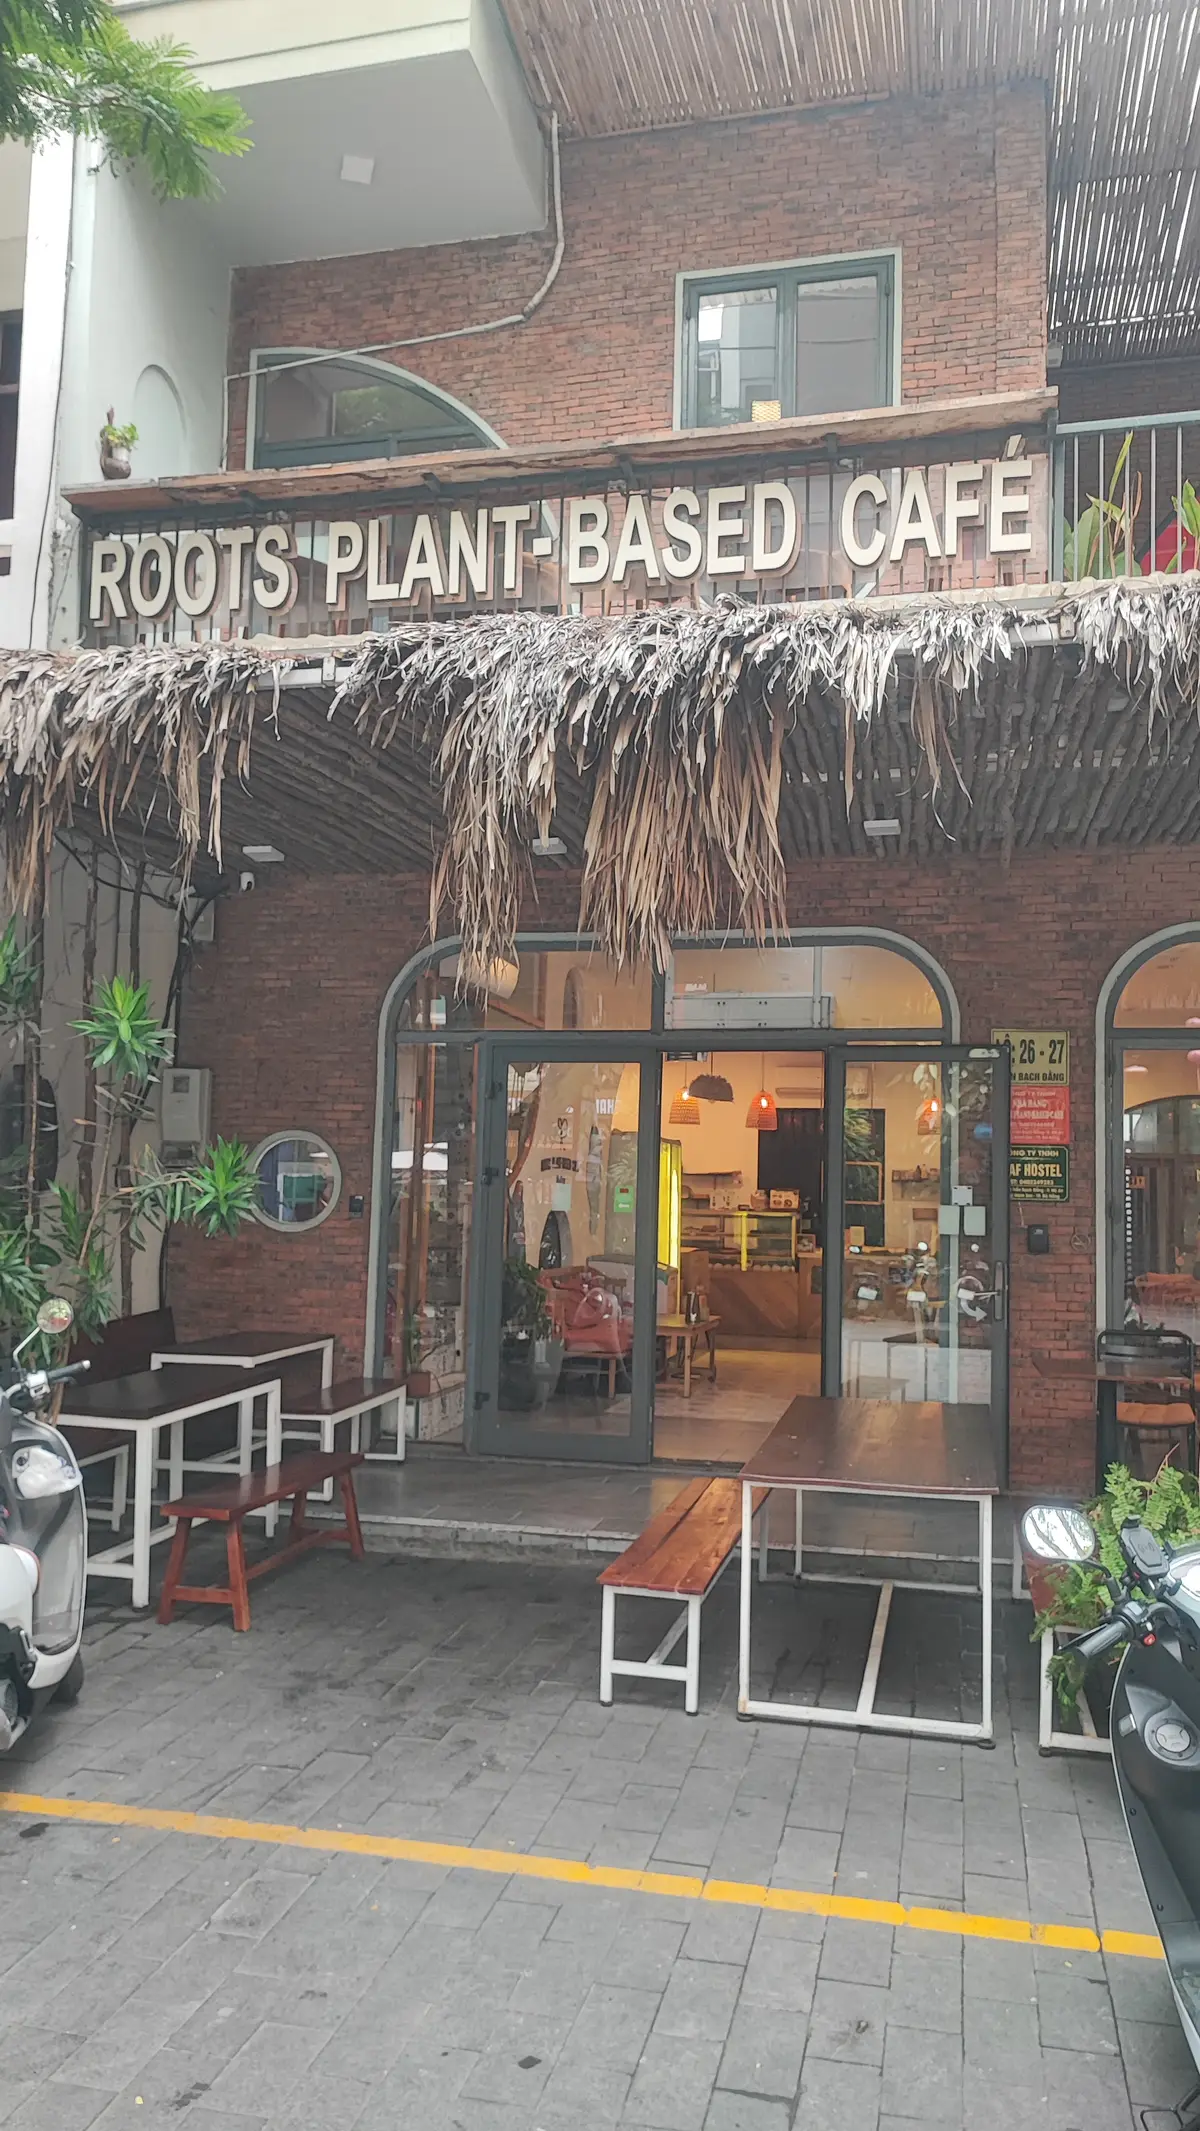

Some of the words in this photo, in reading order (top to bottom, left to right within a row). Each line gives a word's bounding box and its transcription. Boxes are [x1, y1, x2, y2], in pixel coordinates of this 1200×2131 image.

[88, 524, 291, 621] ROOTS
[325, 482, 797, 605] PLANT-BASED
[1019, 1039, 1035, 1064] 26
[1049, 1039, 1065, 1064] 27
[1024, 1164, 1062, 1177] HOSTEL
